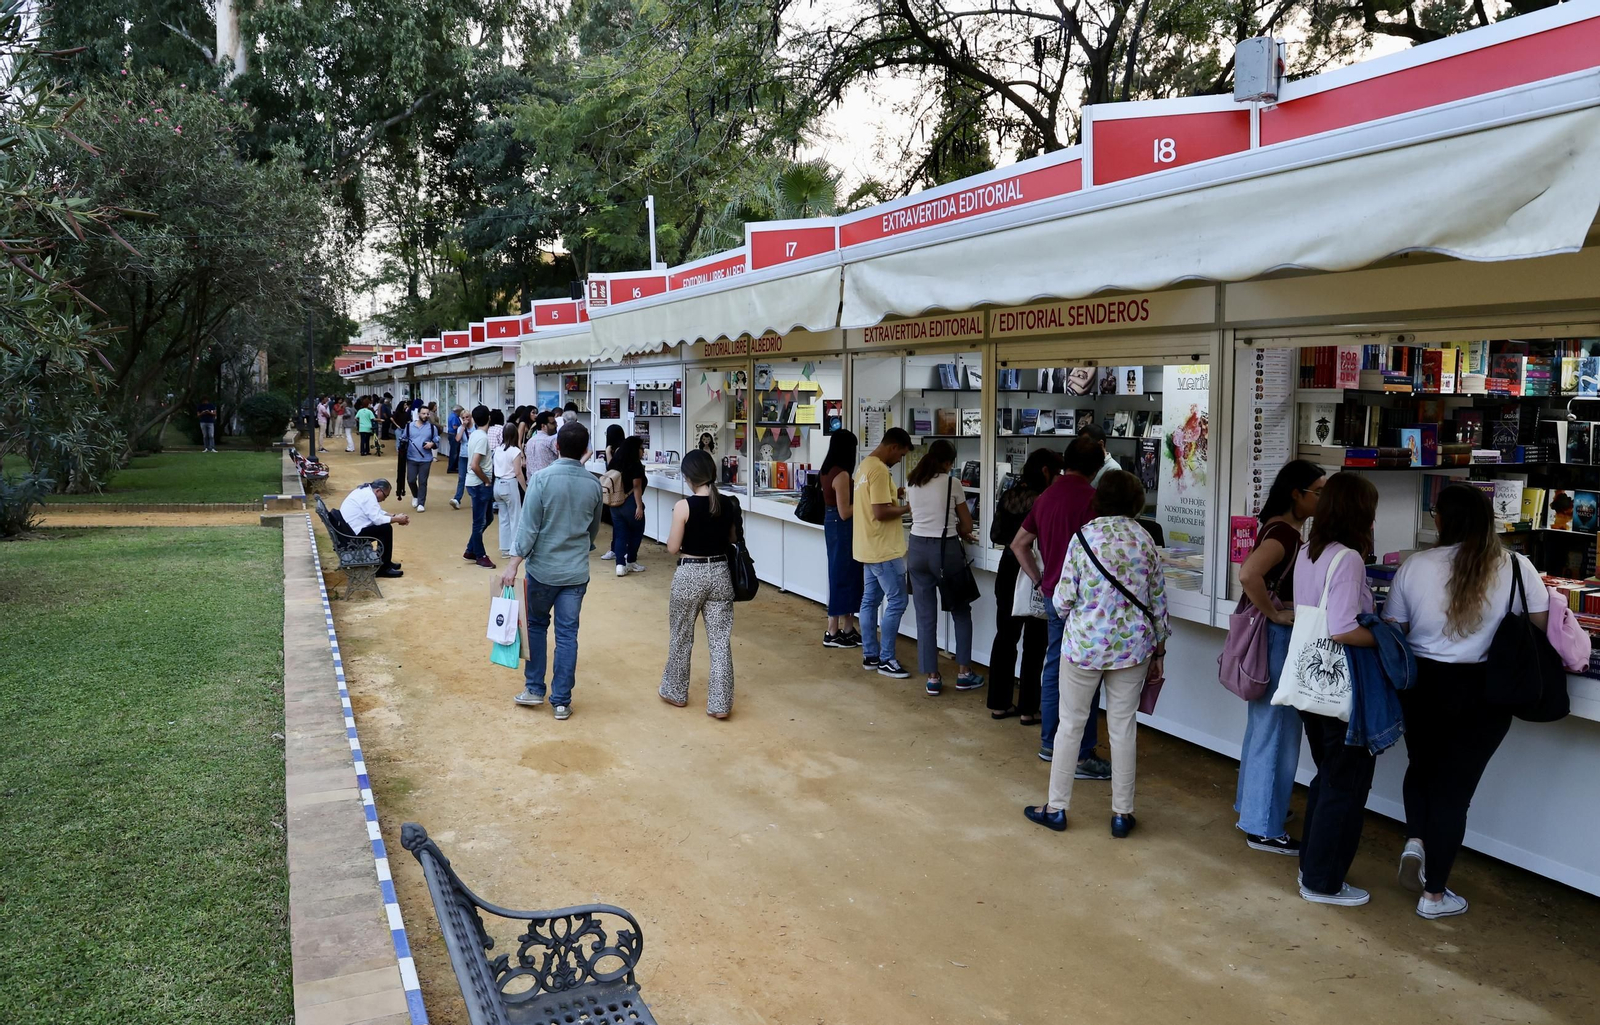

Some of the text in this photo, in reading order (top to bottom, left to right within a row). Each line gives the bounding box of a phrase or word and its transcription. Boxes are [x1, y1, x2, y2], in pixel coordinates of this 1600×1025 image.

[1153, 138, 1177, 163] 18
[882, 179, 1023, 233] EXTRAVERTIDA EDITORIAL
[786, 242, 798, 257] 17
[632, 287, 642, 299] 16
[552, 310, 559, 319] 15
[863, 317, 928, 344] EXTRAVERTIDA
[929, 313, 983, 340] EDITORIAL
[999, 307, 1065, 332] EDITORIAL
[1068, 298, 1150, 326] SENDEROS
[500, 326, 506, 334] 14
[704, 334, 783, 357] EDITORIAL LIBRE ALBEDRÍO
[1177, 374, 1210, 390] verti
[1340, 372, 1356, 382] DEN
[1180, 497, 1188, 505] YO
[1164, 505, 1193, 515] NOSOTROS
[1167, 515, 1198, 526] DEJÉMOSLE
